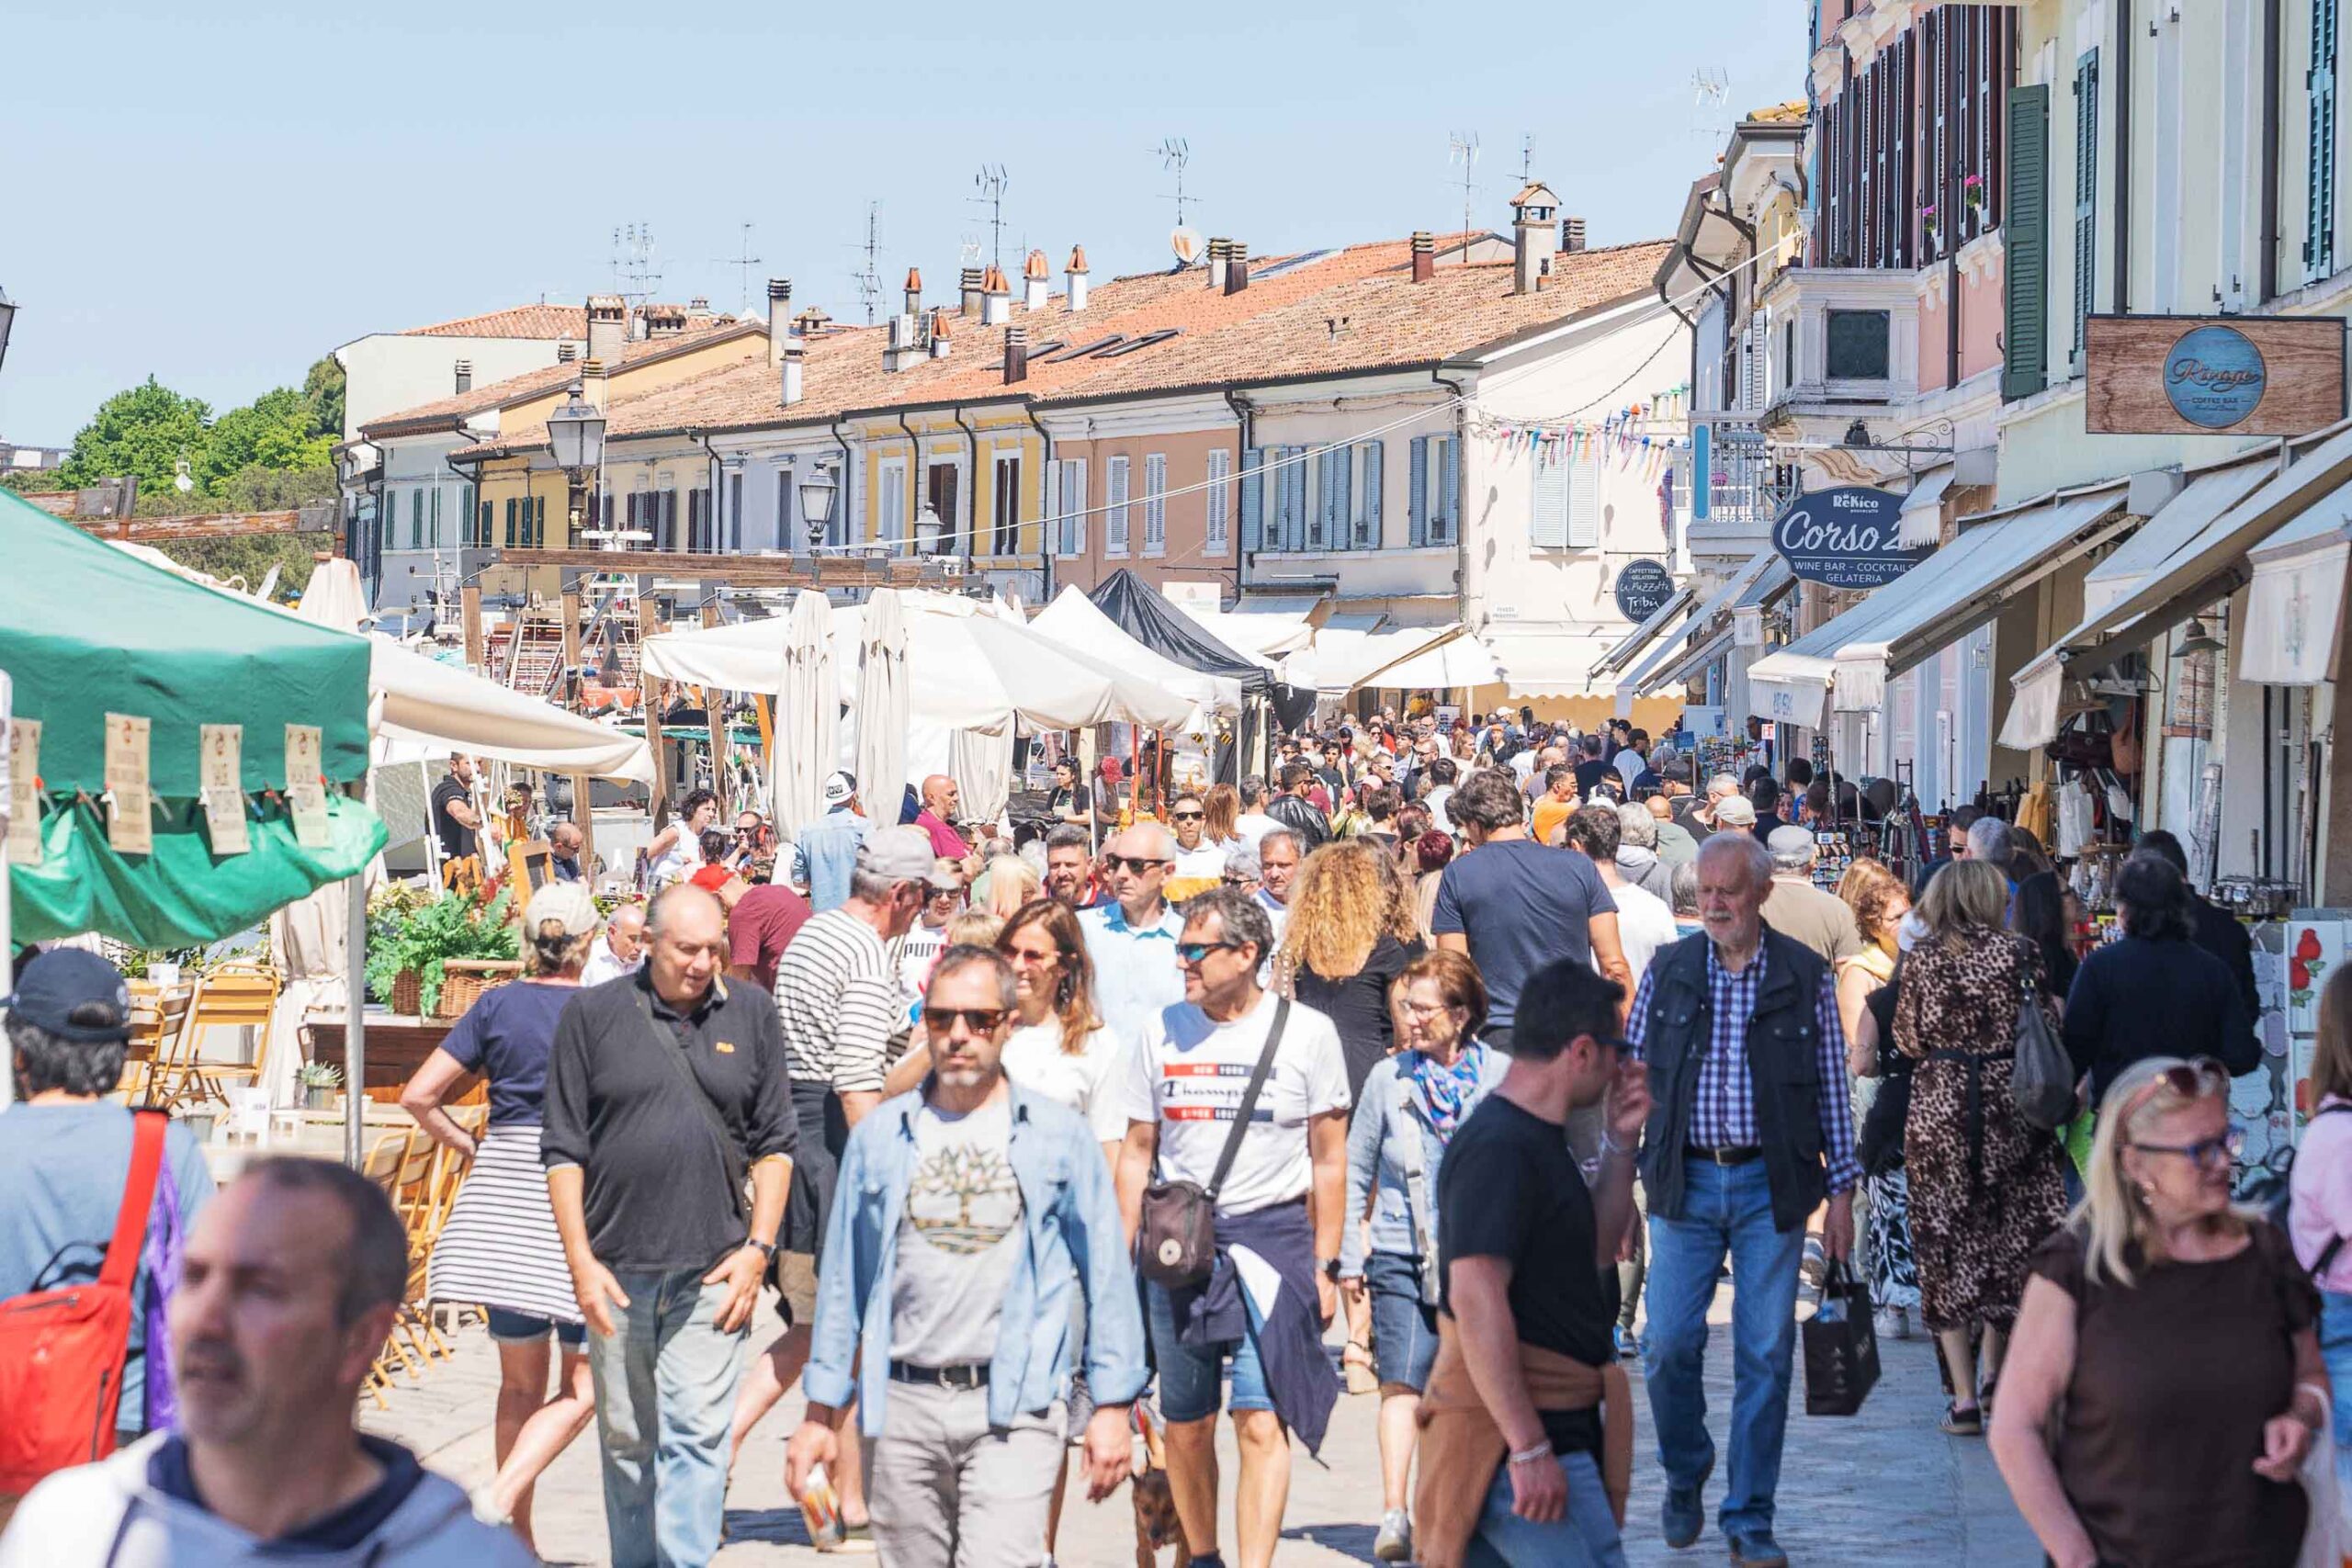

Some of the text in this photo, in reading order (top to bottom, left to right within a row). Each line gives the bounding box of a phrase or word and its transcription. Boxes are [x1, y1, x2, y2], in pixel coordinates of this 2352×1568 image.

[1781, 511, 1901, 551] Corso 2
[1794, 561, 1821, 570] WINE
[1825, 562, 1846, 571] BAR
[1826, 573, 1883, 583] GELATERIA
